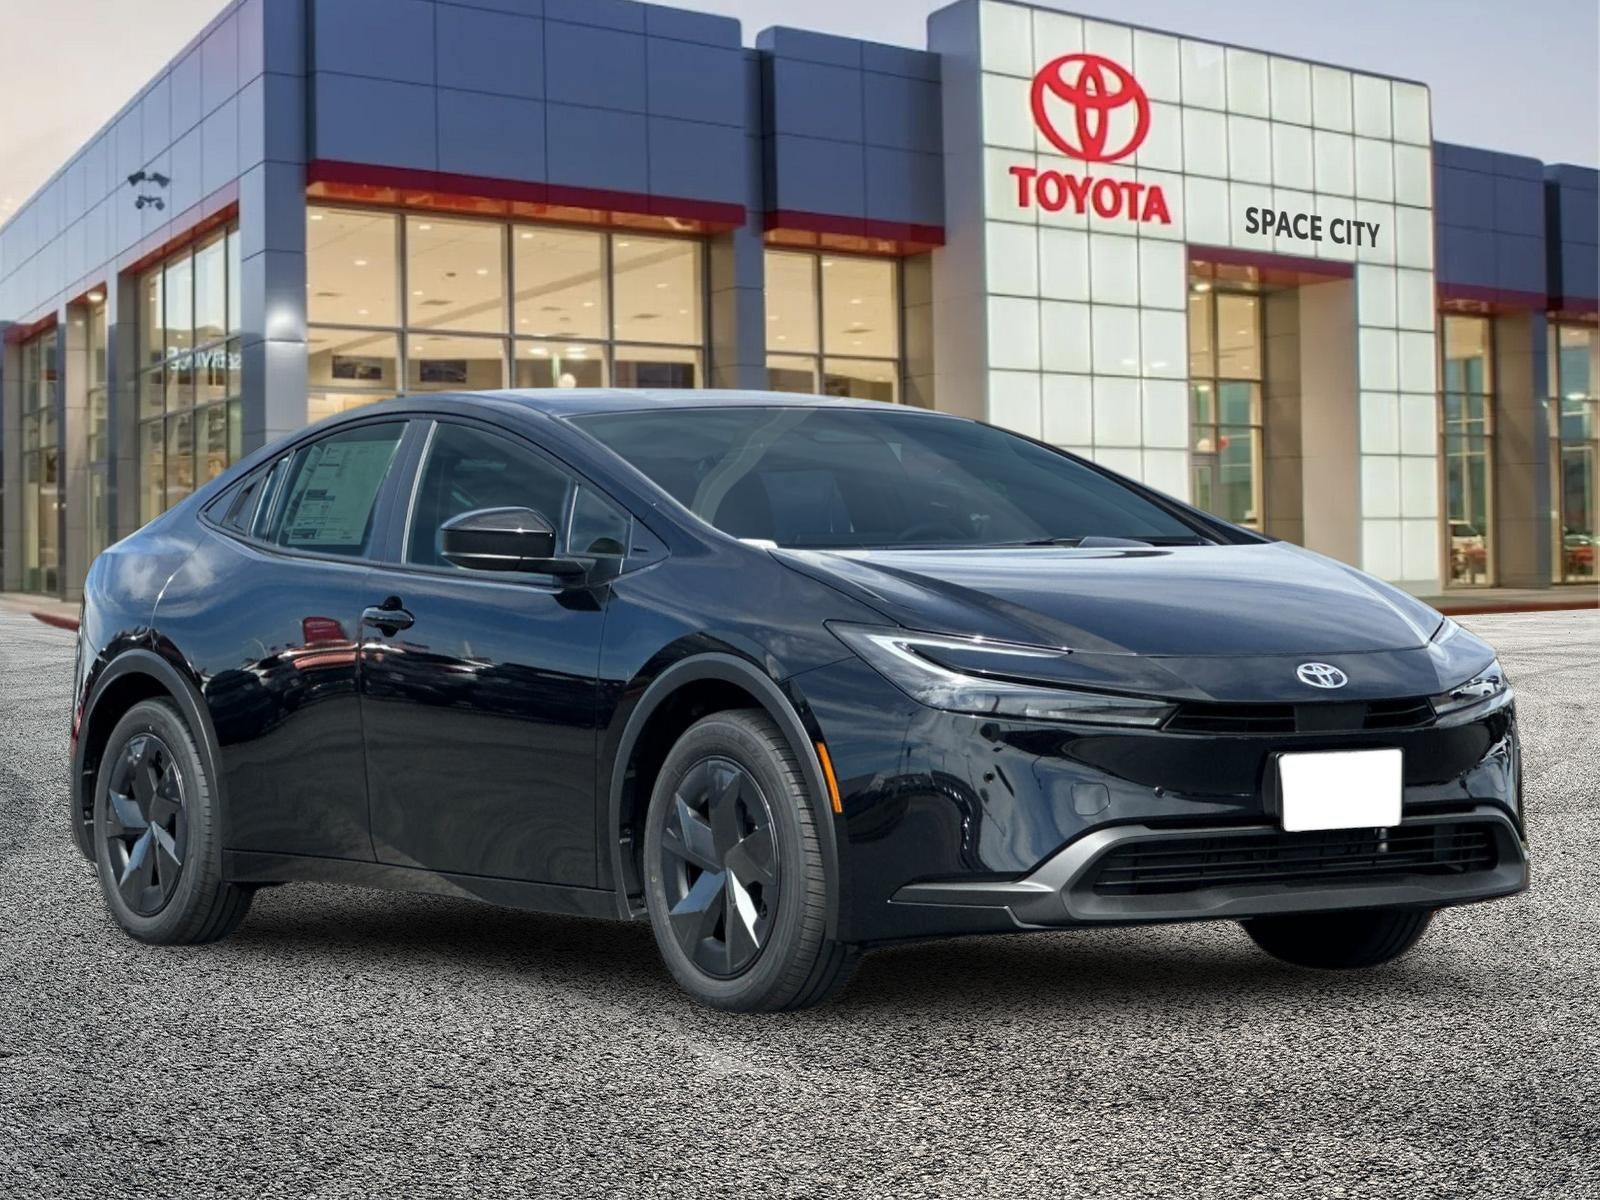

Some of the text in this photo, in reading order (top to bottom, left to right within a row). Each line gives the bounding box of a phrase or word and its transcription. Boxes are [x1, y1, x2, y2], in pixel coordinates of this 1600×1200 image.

[1009, 166, 1171, 224] TOYOTA
[1245, 206, 1380, 248] SPACE CITY
